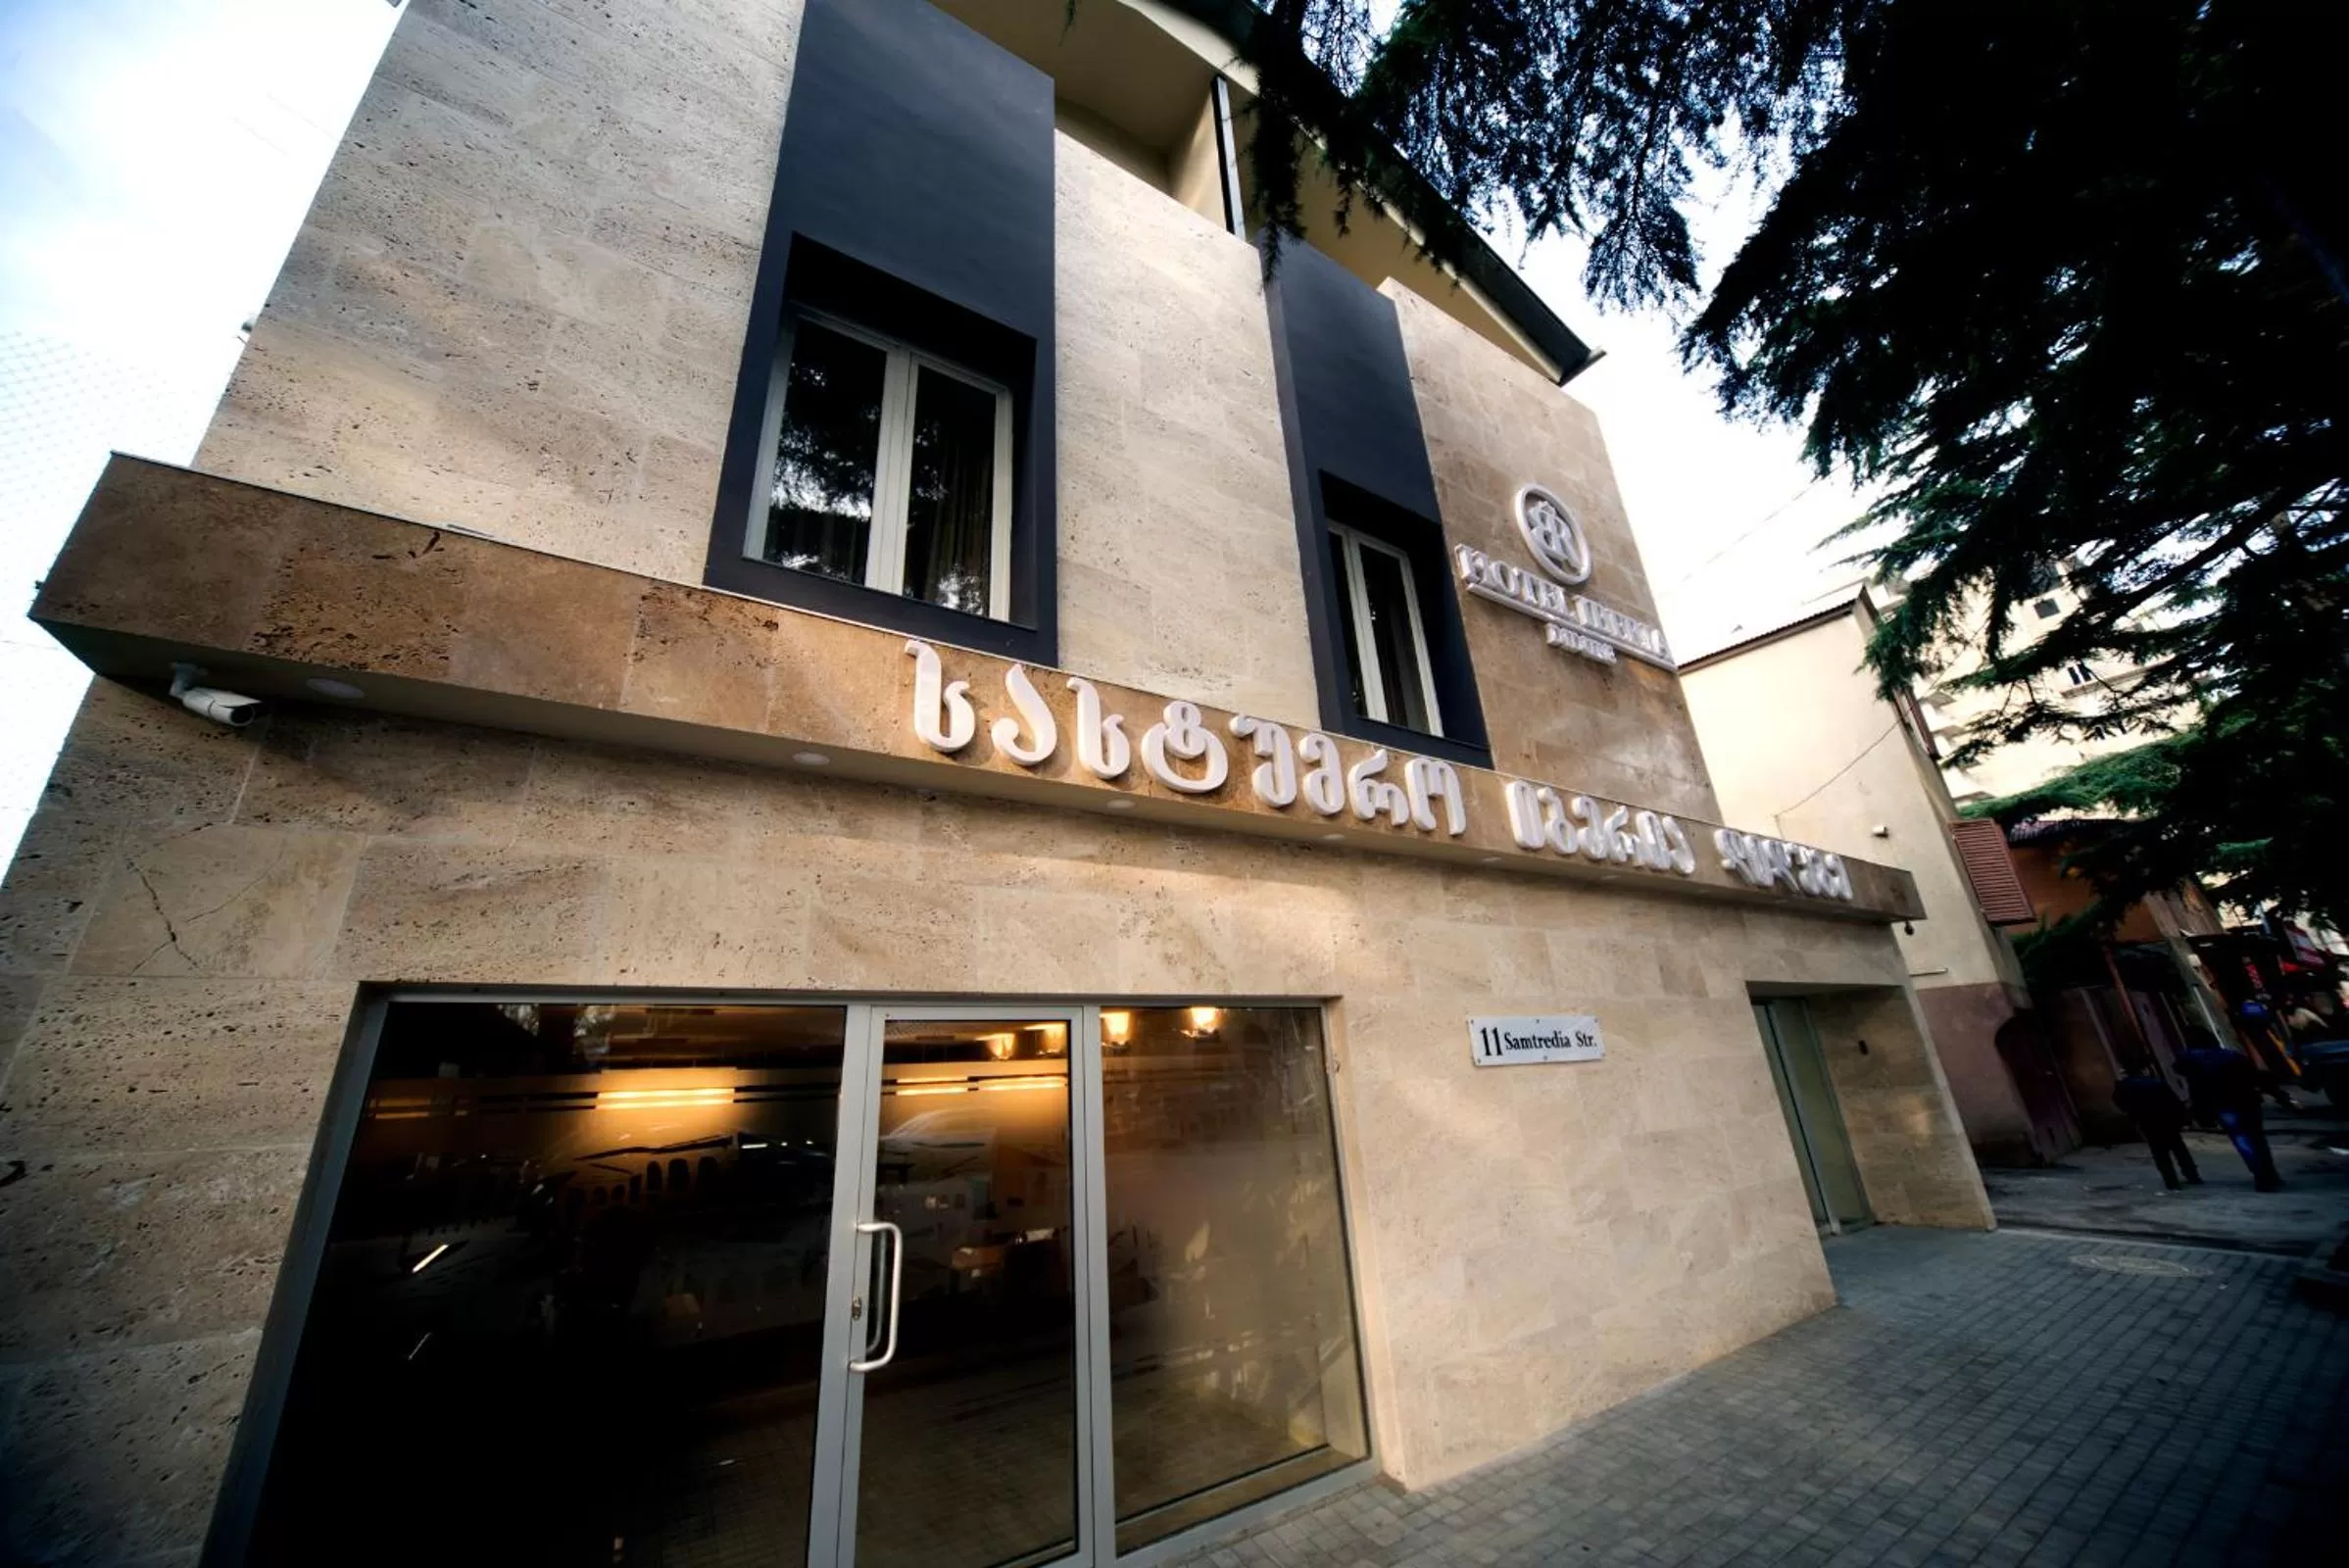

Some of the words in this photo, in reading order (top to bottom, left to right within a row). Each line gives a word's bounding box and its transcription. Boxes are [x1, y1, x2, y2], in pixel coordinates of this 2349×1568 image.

[1454, 543, 1572, 619] HOTEL
[905, 639, 1466, 836] სასტუმრო
[1480, 1027, 1503, 1056] 11
[1504, 1030, 1572, 1051] Samtredia
[1575, 1031, 1597, 1048] Str.
